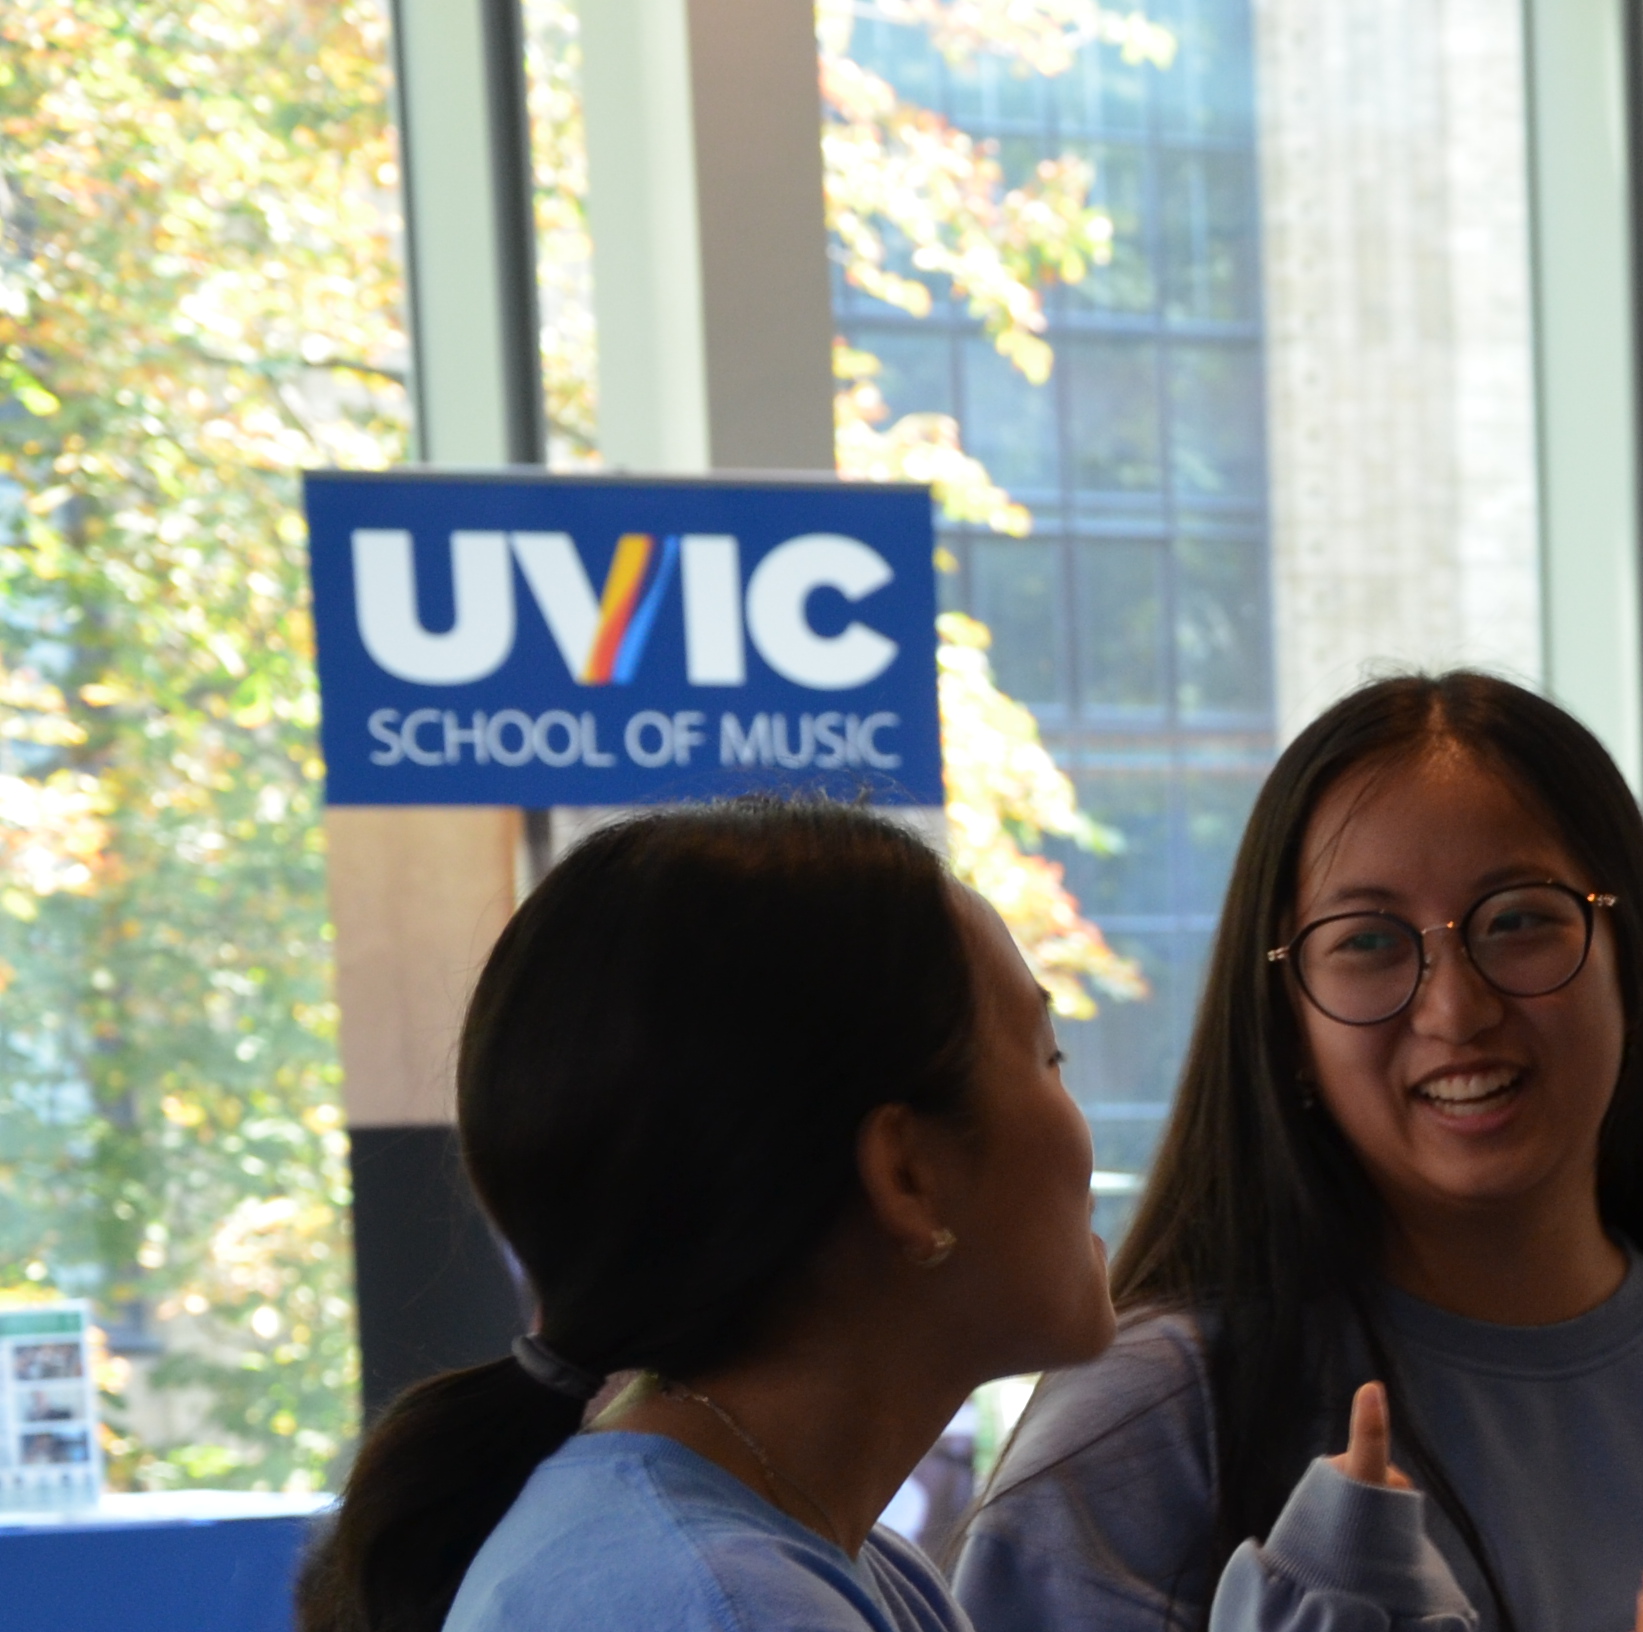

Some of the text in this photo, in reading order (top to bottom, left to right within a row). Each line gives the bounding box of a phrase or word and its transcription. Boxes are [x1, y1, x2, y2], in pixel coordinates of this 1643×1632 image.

[350, 527, 900, 690] UVIC
[367, 707, 902, 770] SCHOOL OF MUSIC
